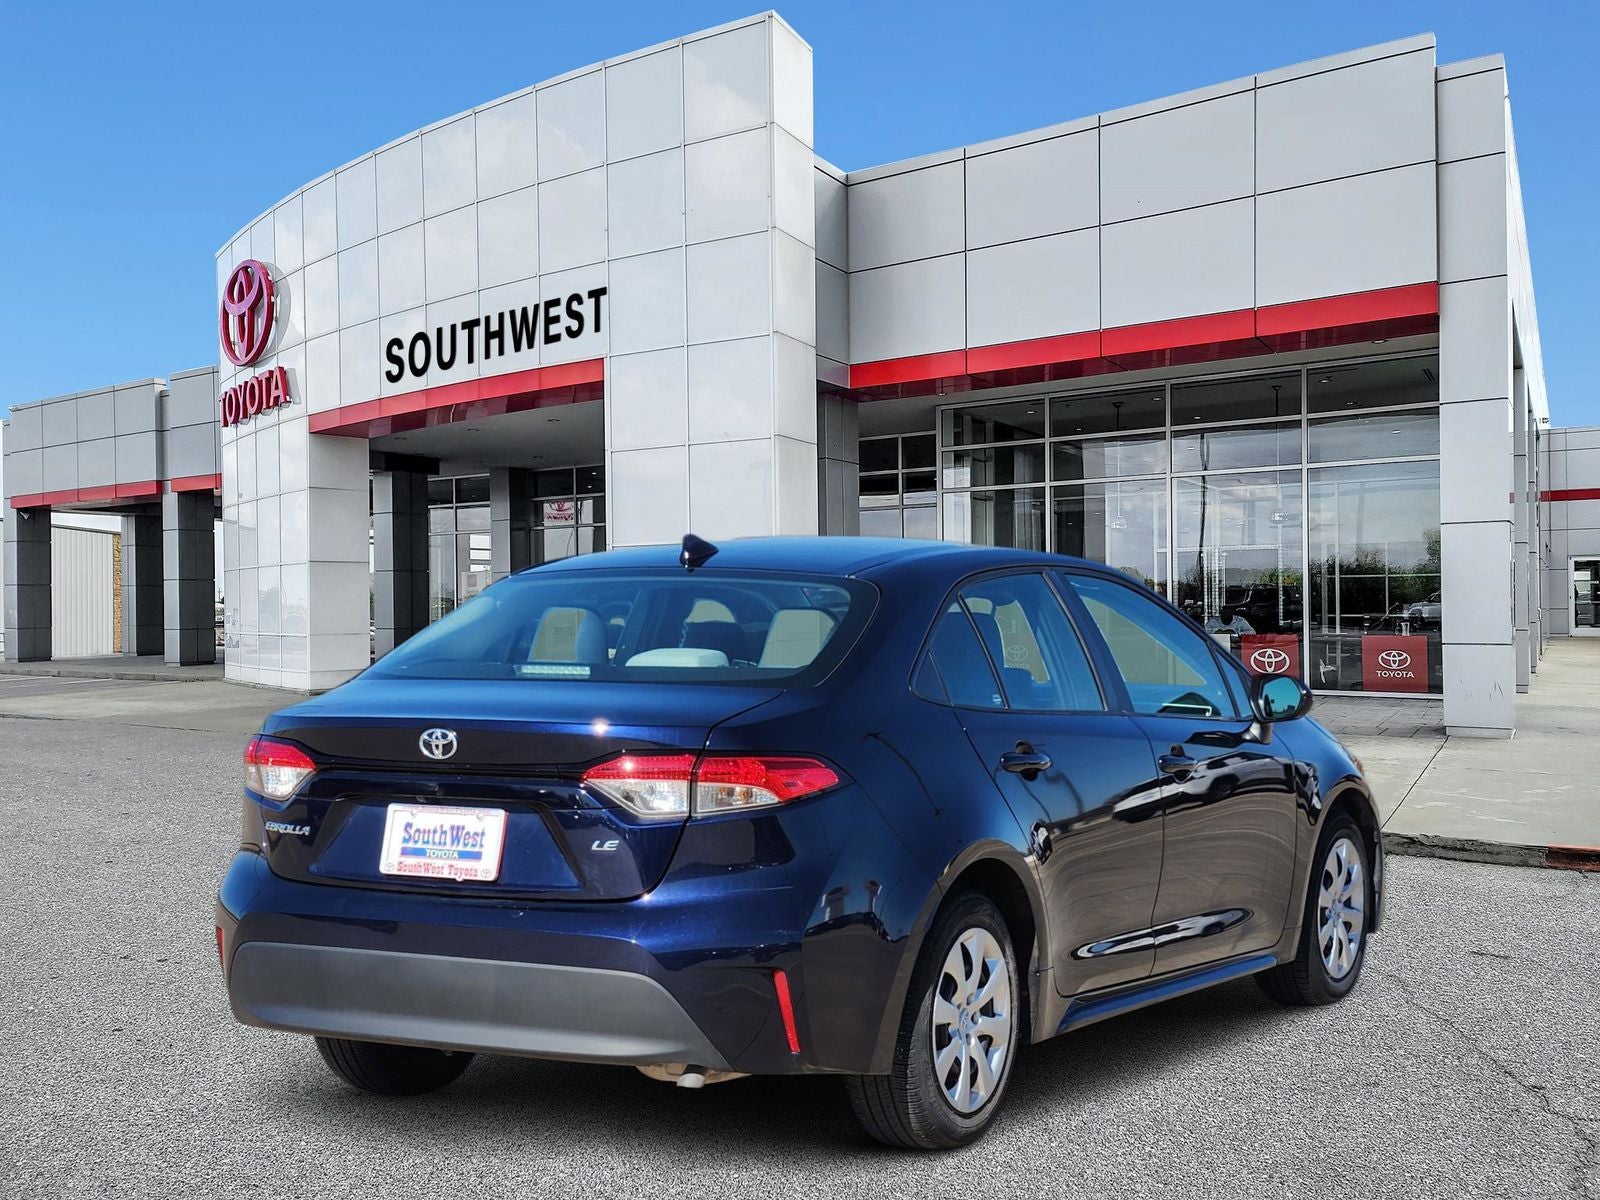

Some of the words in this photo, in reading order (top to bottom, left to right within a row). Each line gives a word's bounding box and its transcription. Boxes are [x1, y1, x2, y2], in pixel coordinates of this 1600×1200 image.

[385, 286, 608, 383] SOUTHWEST
[218, 366, 290, 427] TOYOTA
[1376, 670, 1415, 678] TOYOTA
[591, 840, 619, 850] LE
[426, 849, 459, 859] TOYOTA
[448, 864, 478, 877] Toyota
